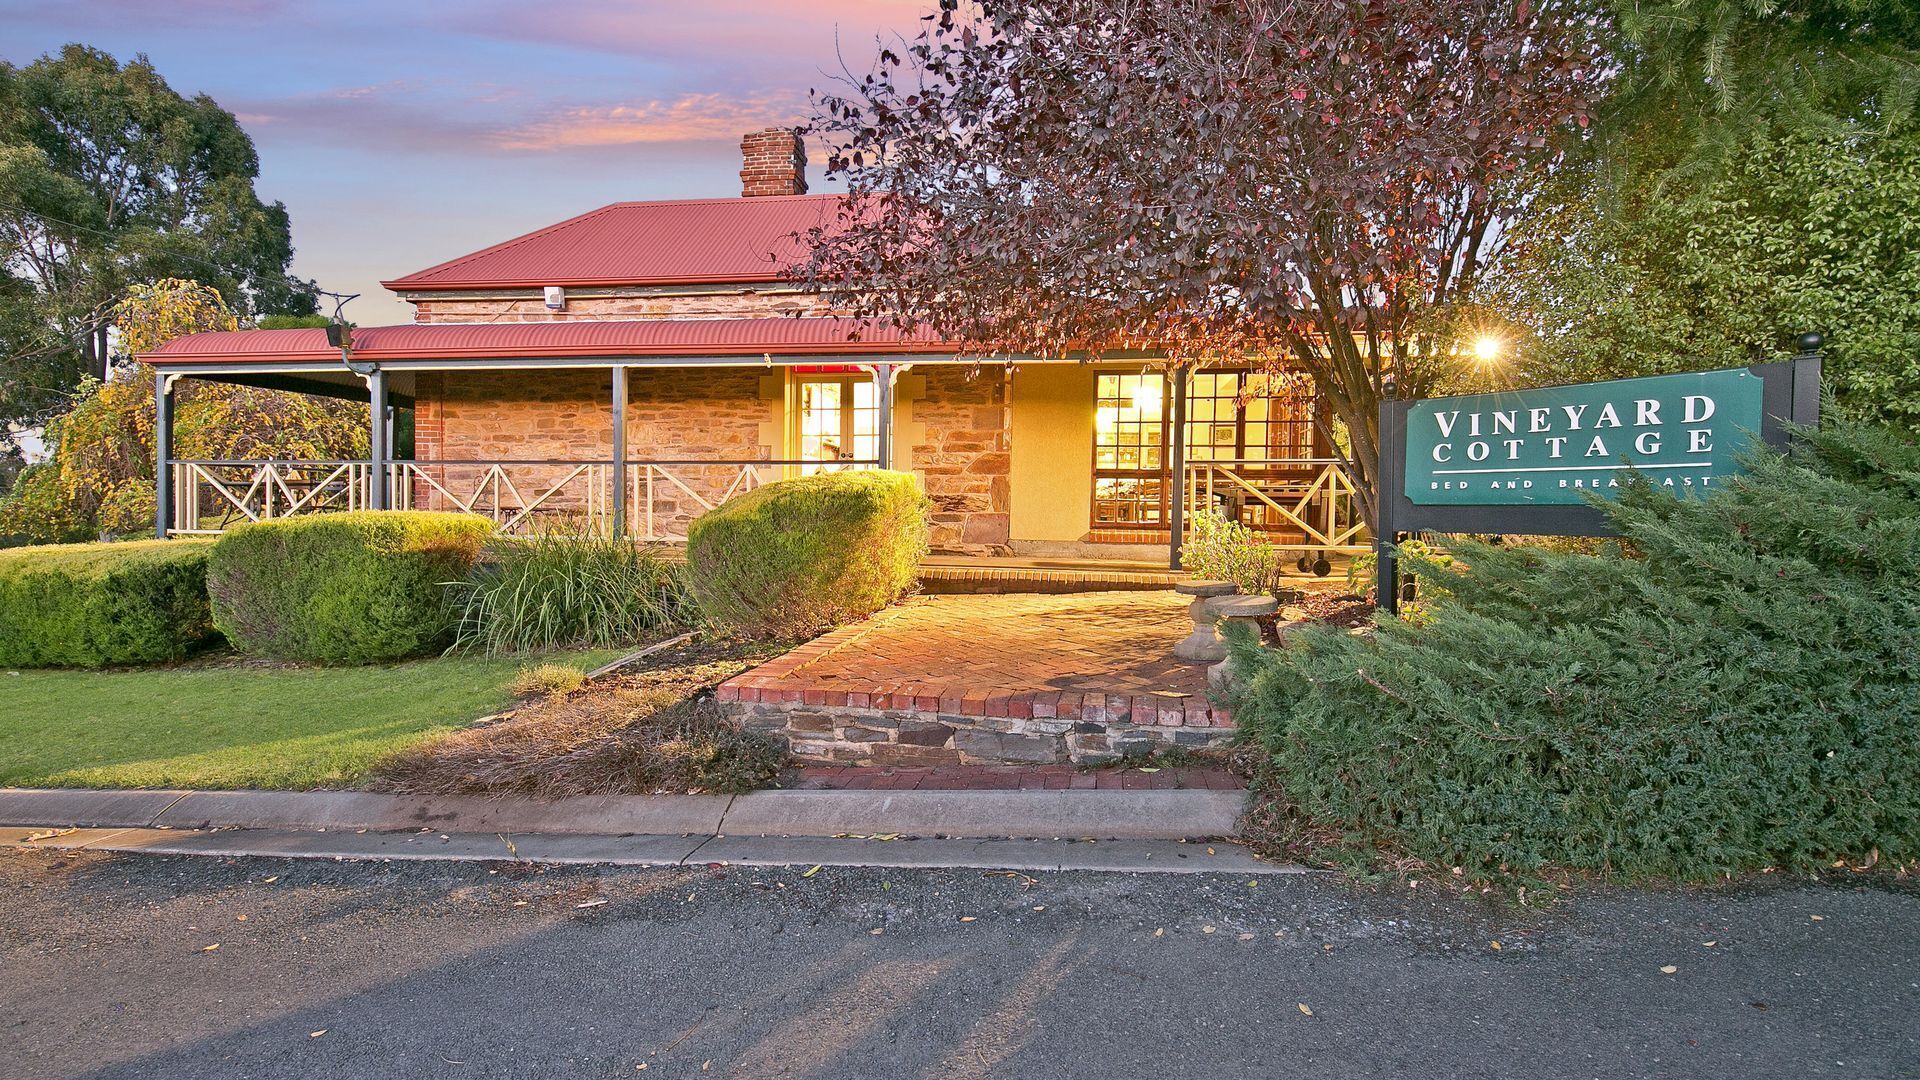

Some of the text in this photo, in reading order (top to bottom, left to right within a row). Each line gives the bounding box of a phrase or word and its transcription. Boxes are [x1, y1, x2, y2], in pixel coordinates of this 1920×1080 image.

[1433, 395, 1716, 438] VINEYARD
[1432, 429, 1713, 463] COTTAGE
[1432, 476, 1711, 491] BED AND BREAAST
